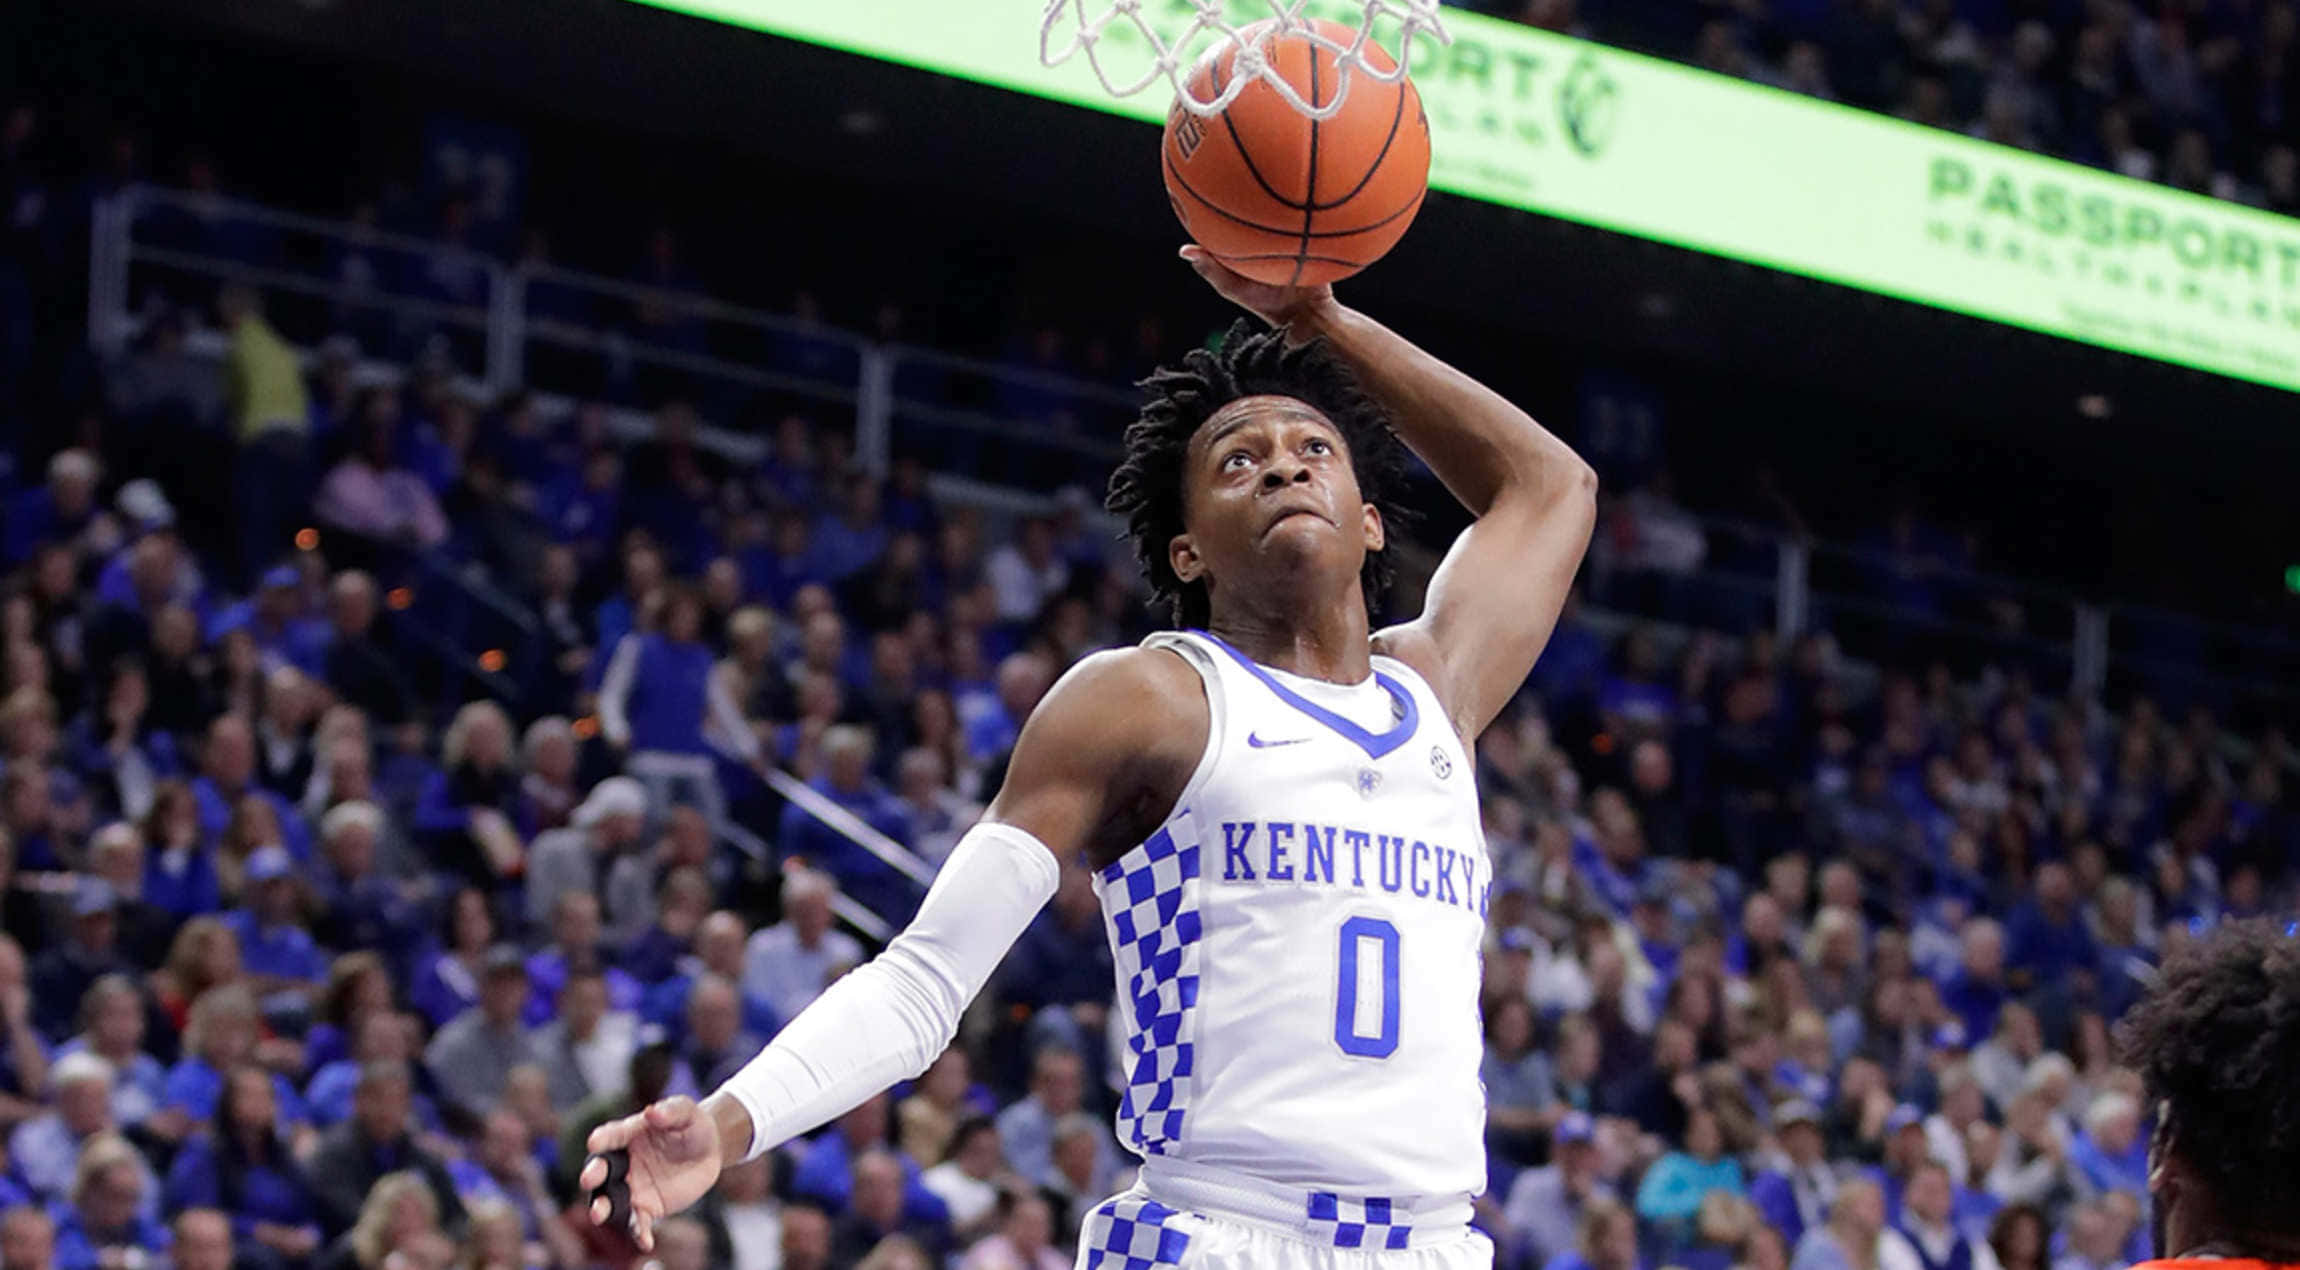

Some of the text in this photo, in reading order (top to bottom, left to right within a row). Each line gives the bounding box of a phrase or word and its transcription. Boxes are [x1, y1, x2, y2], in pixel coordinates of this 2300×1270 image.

[1927, 154, 2300, 290] PASSPORT
[1221, 821, 1475, 911] KENTUCKY
[1333, 914, 1401, 1060] 0
